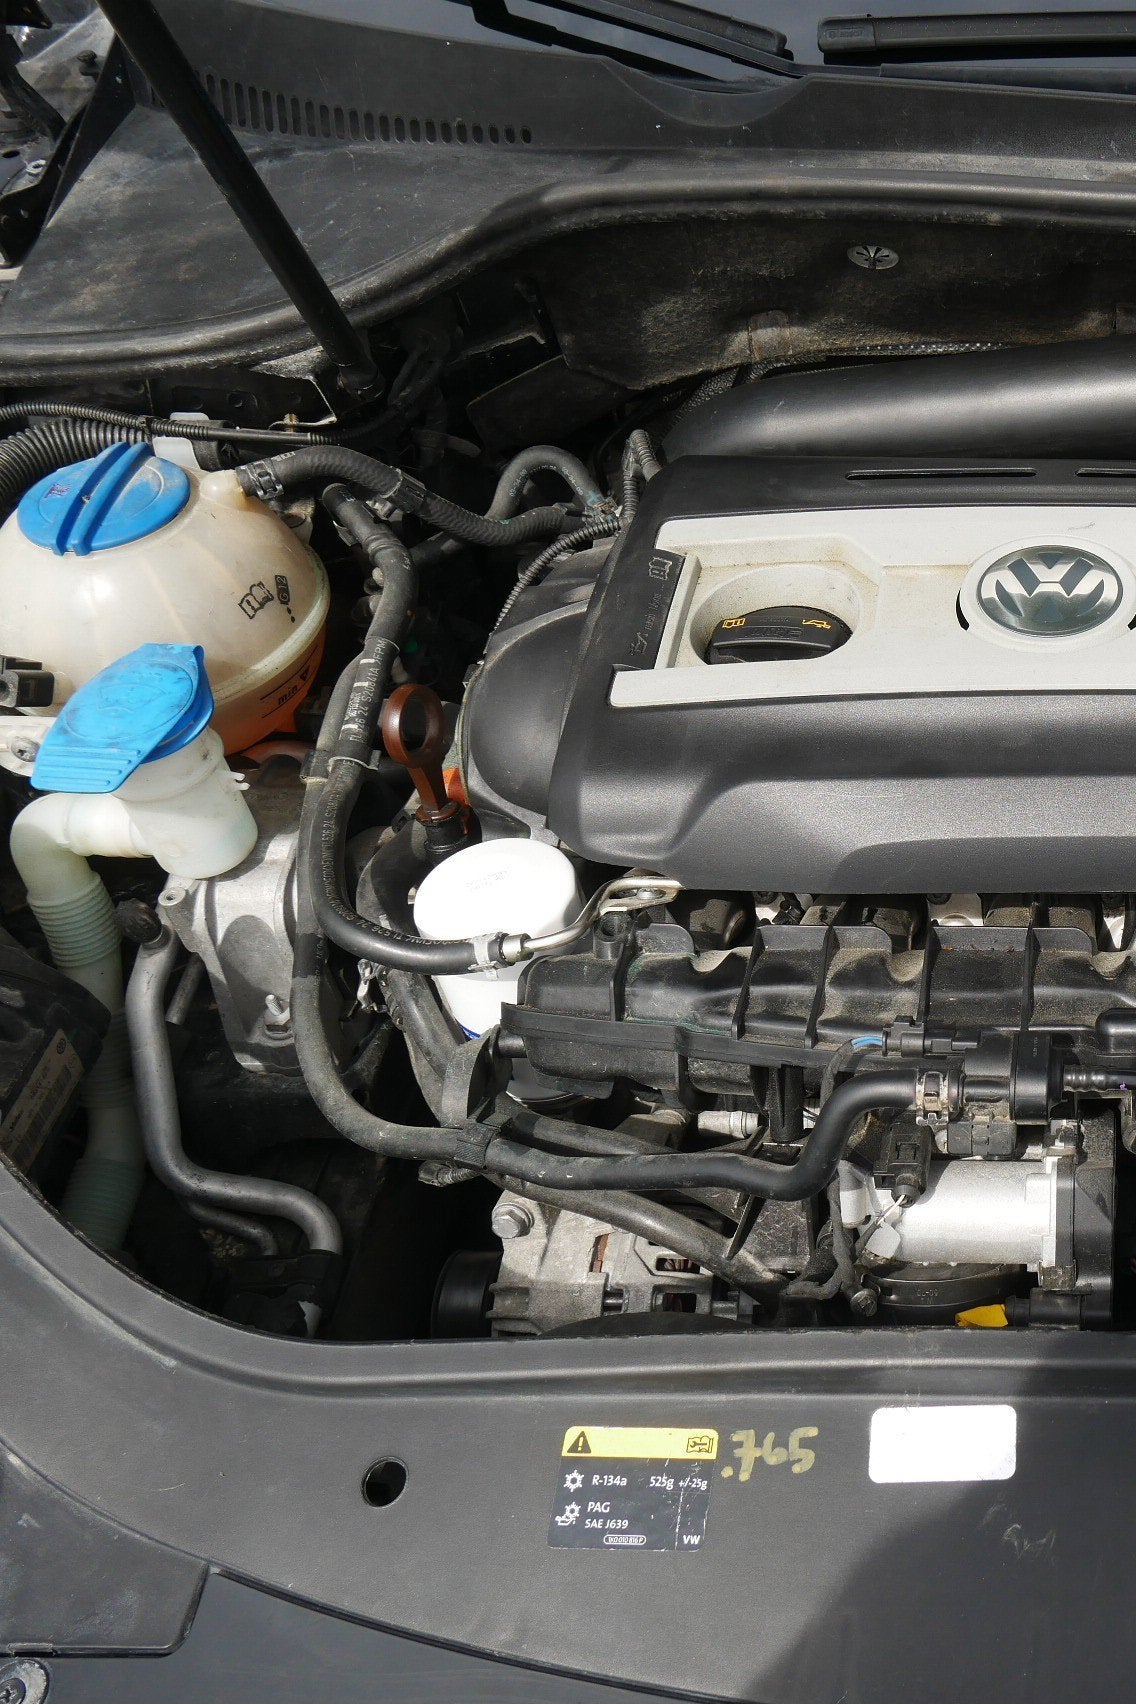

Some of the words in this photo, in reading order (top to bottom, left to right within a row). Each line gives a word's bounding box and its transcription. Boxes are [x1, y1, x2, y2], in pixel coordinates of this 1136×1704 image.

[278, 685, 298, 704] min
[592, 1475, 627, 1486] R-134a
[650, 1476, 674, 1490] 525g
[679, 1477, 707, 1490] +/-25g
[587, 1502, 610, 1513] PAG
[585, 1519, 602, 1528] SAE
[605, 1519, 628, 1529] J639
[683, 1535, 700, 1544] VW
